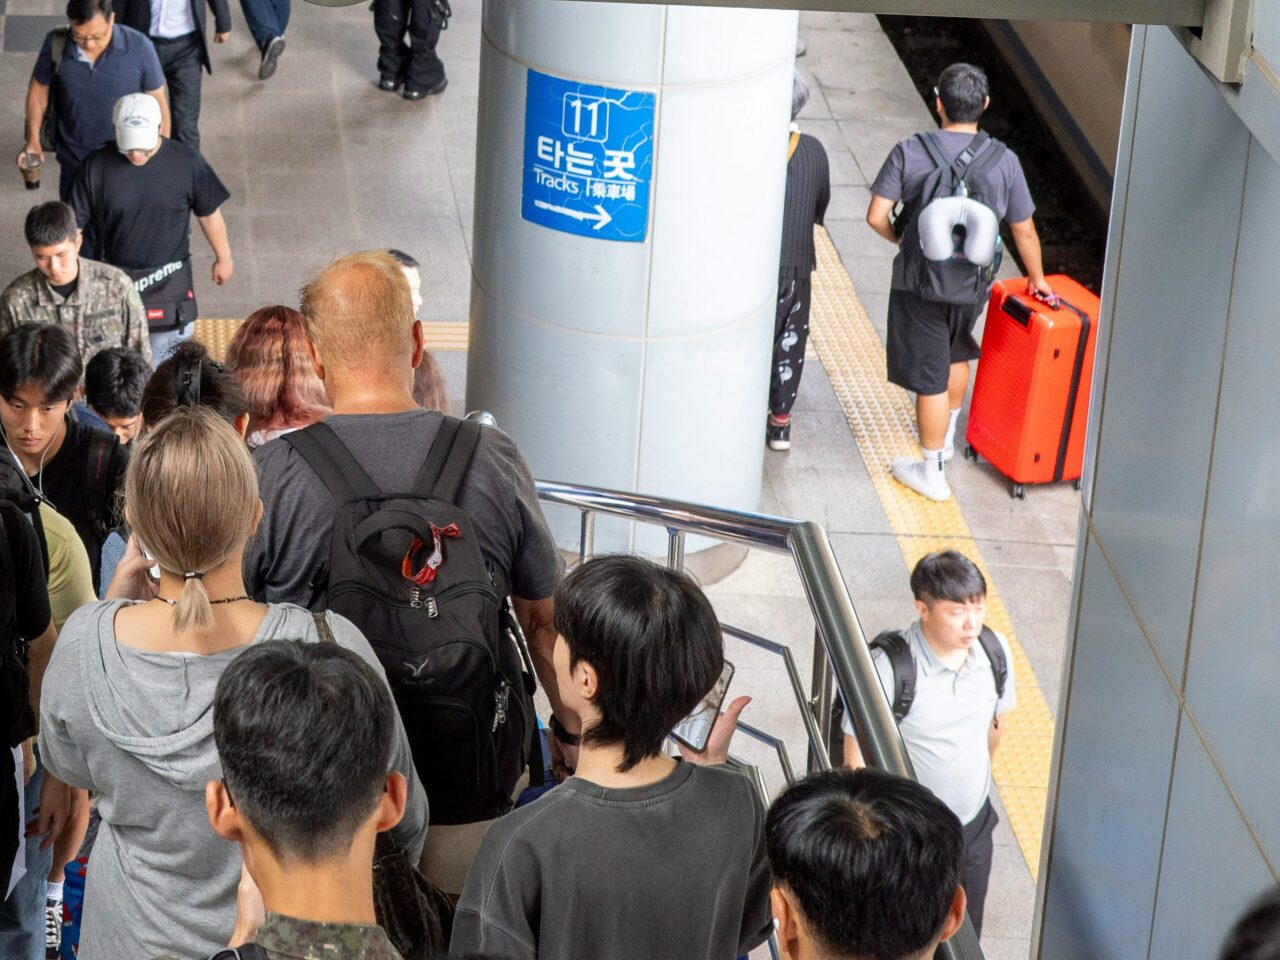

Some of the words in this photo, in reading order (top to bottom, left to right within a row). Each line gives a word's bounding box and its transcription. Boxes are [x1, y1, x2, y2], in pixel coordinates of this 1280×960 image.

[571, 100, 598, 136] 11
[537, 135, 595, 176] 타는
[603, 149, 636, 180] 곳
[534, 167, 579, 195] Tracks
